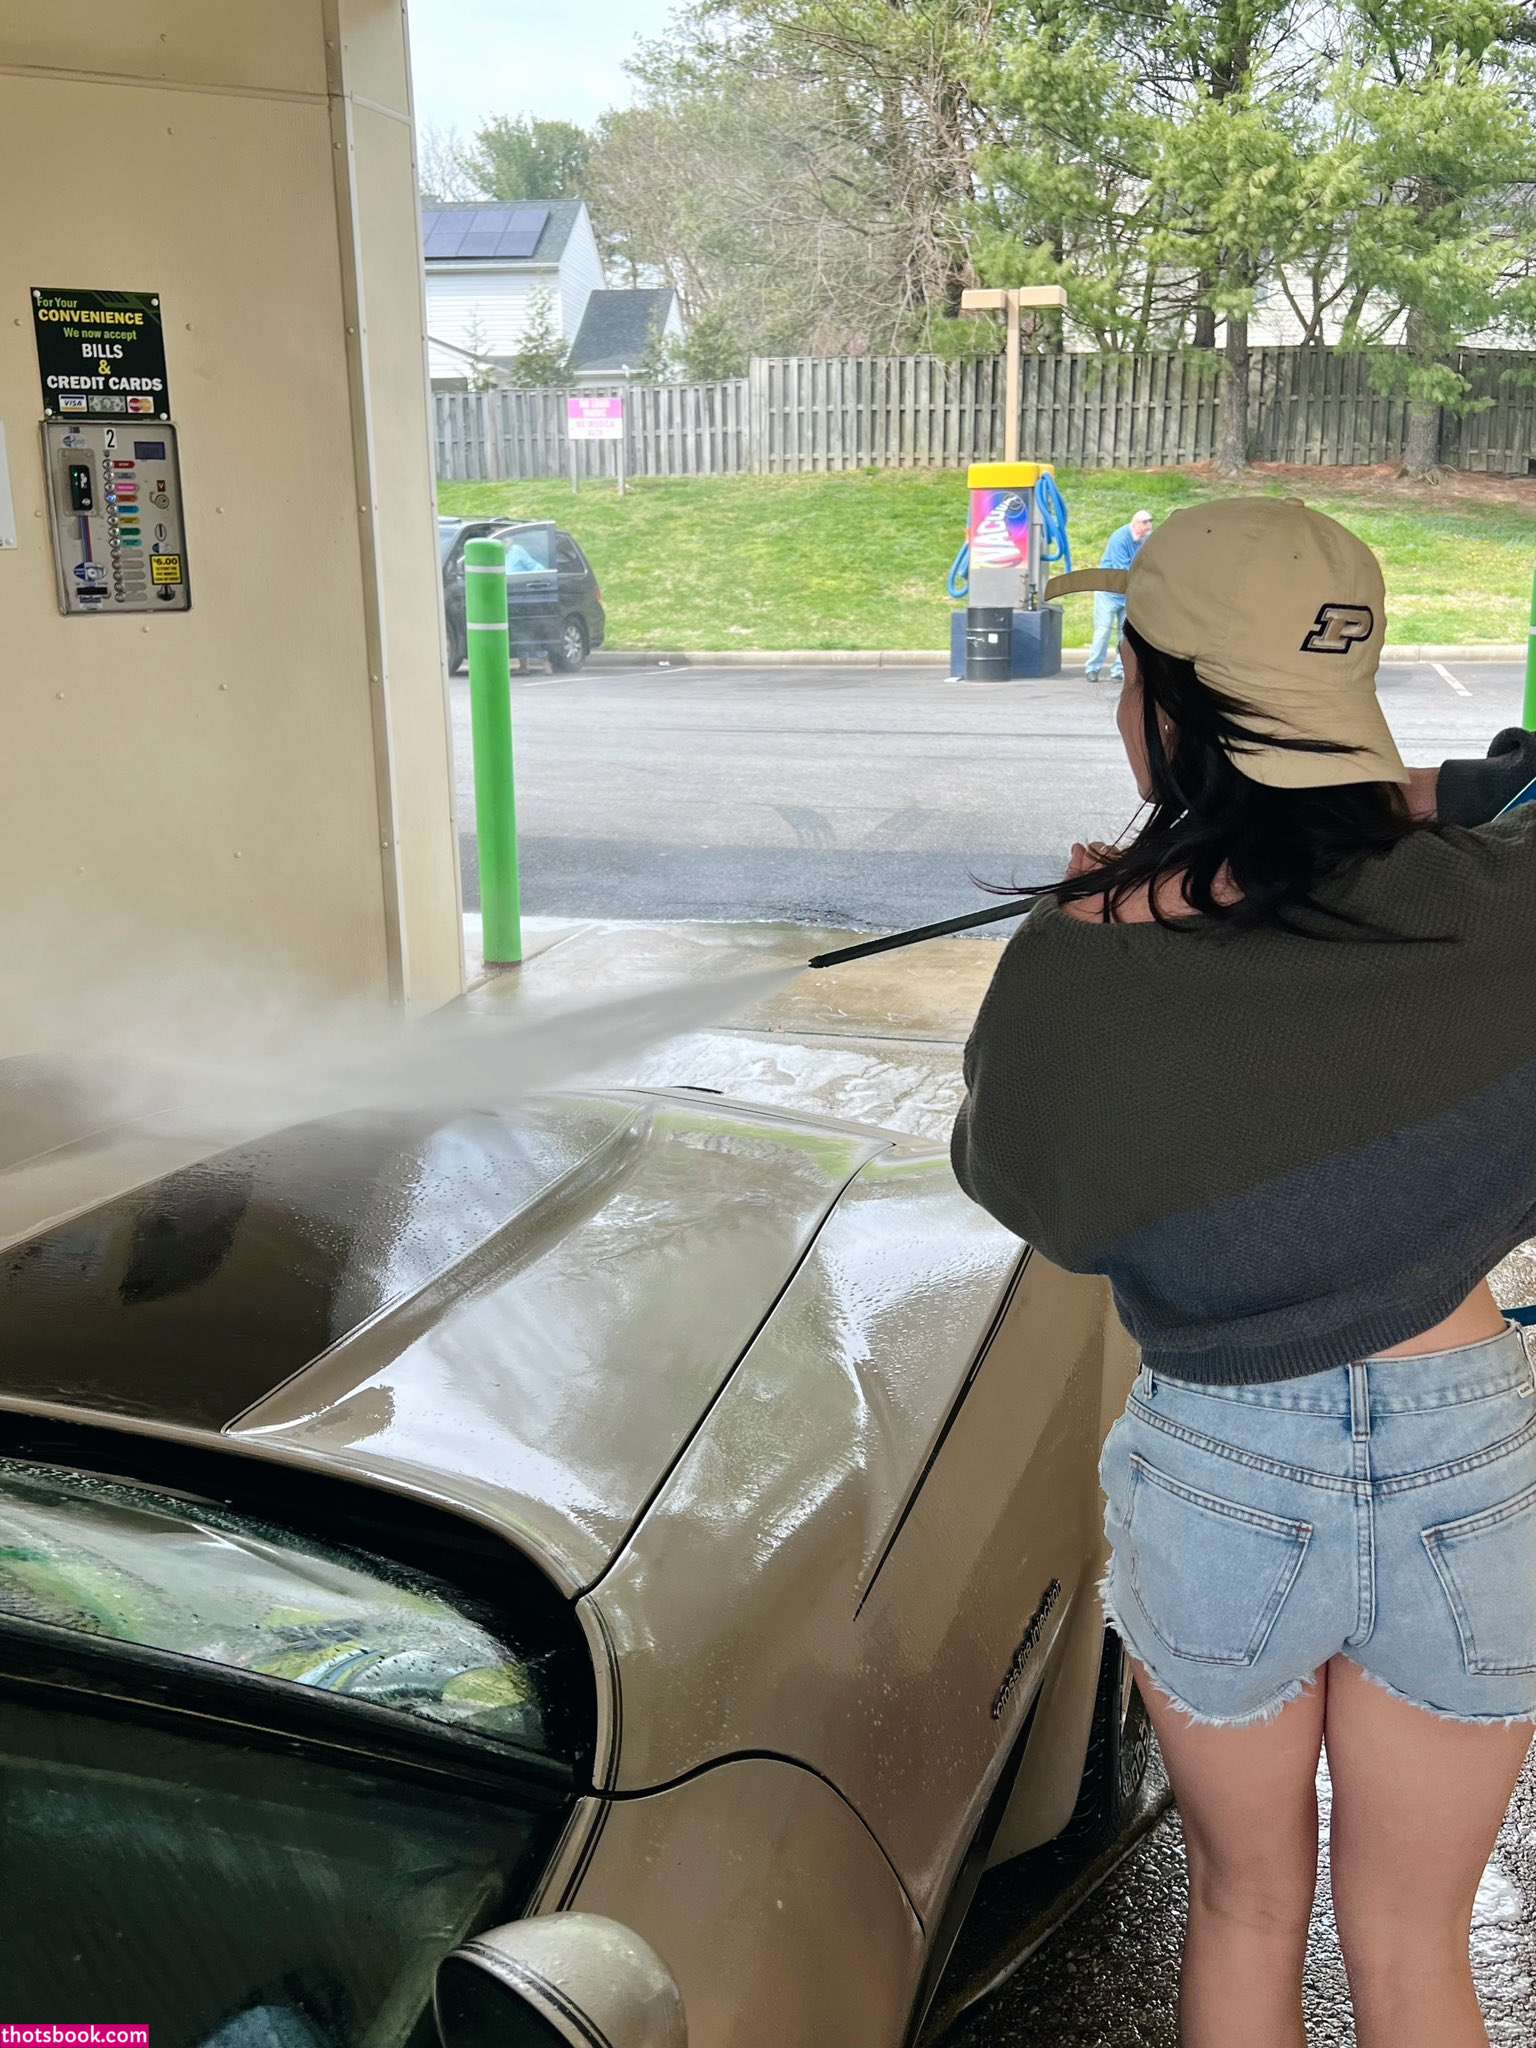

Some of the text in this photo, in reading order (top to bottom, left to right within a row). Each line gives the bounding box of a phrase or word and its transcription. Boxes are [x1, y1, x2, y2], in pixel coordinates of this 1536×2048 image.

[36, 297, 78, 308] For Your
[38, 309, 144, 325] CONVENIENCE
[63, 328, 137, 341] We now accept
[81, 343, 123, 359] BILLS
[98, 360, 111, 375] &
[46, 375, 163, 391] CREDIT CARDS
[63, 399, 83, 407] VISA
[105, 429, 116, 449] 2
[1299, 603, 1374, 655] P
